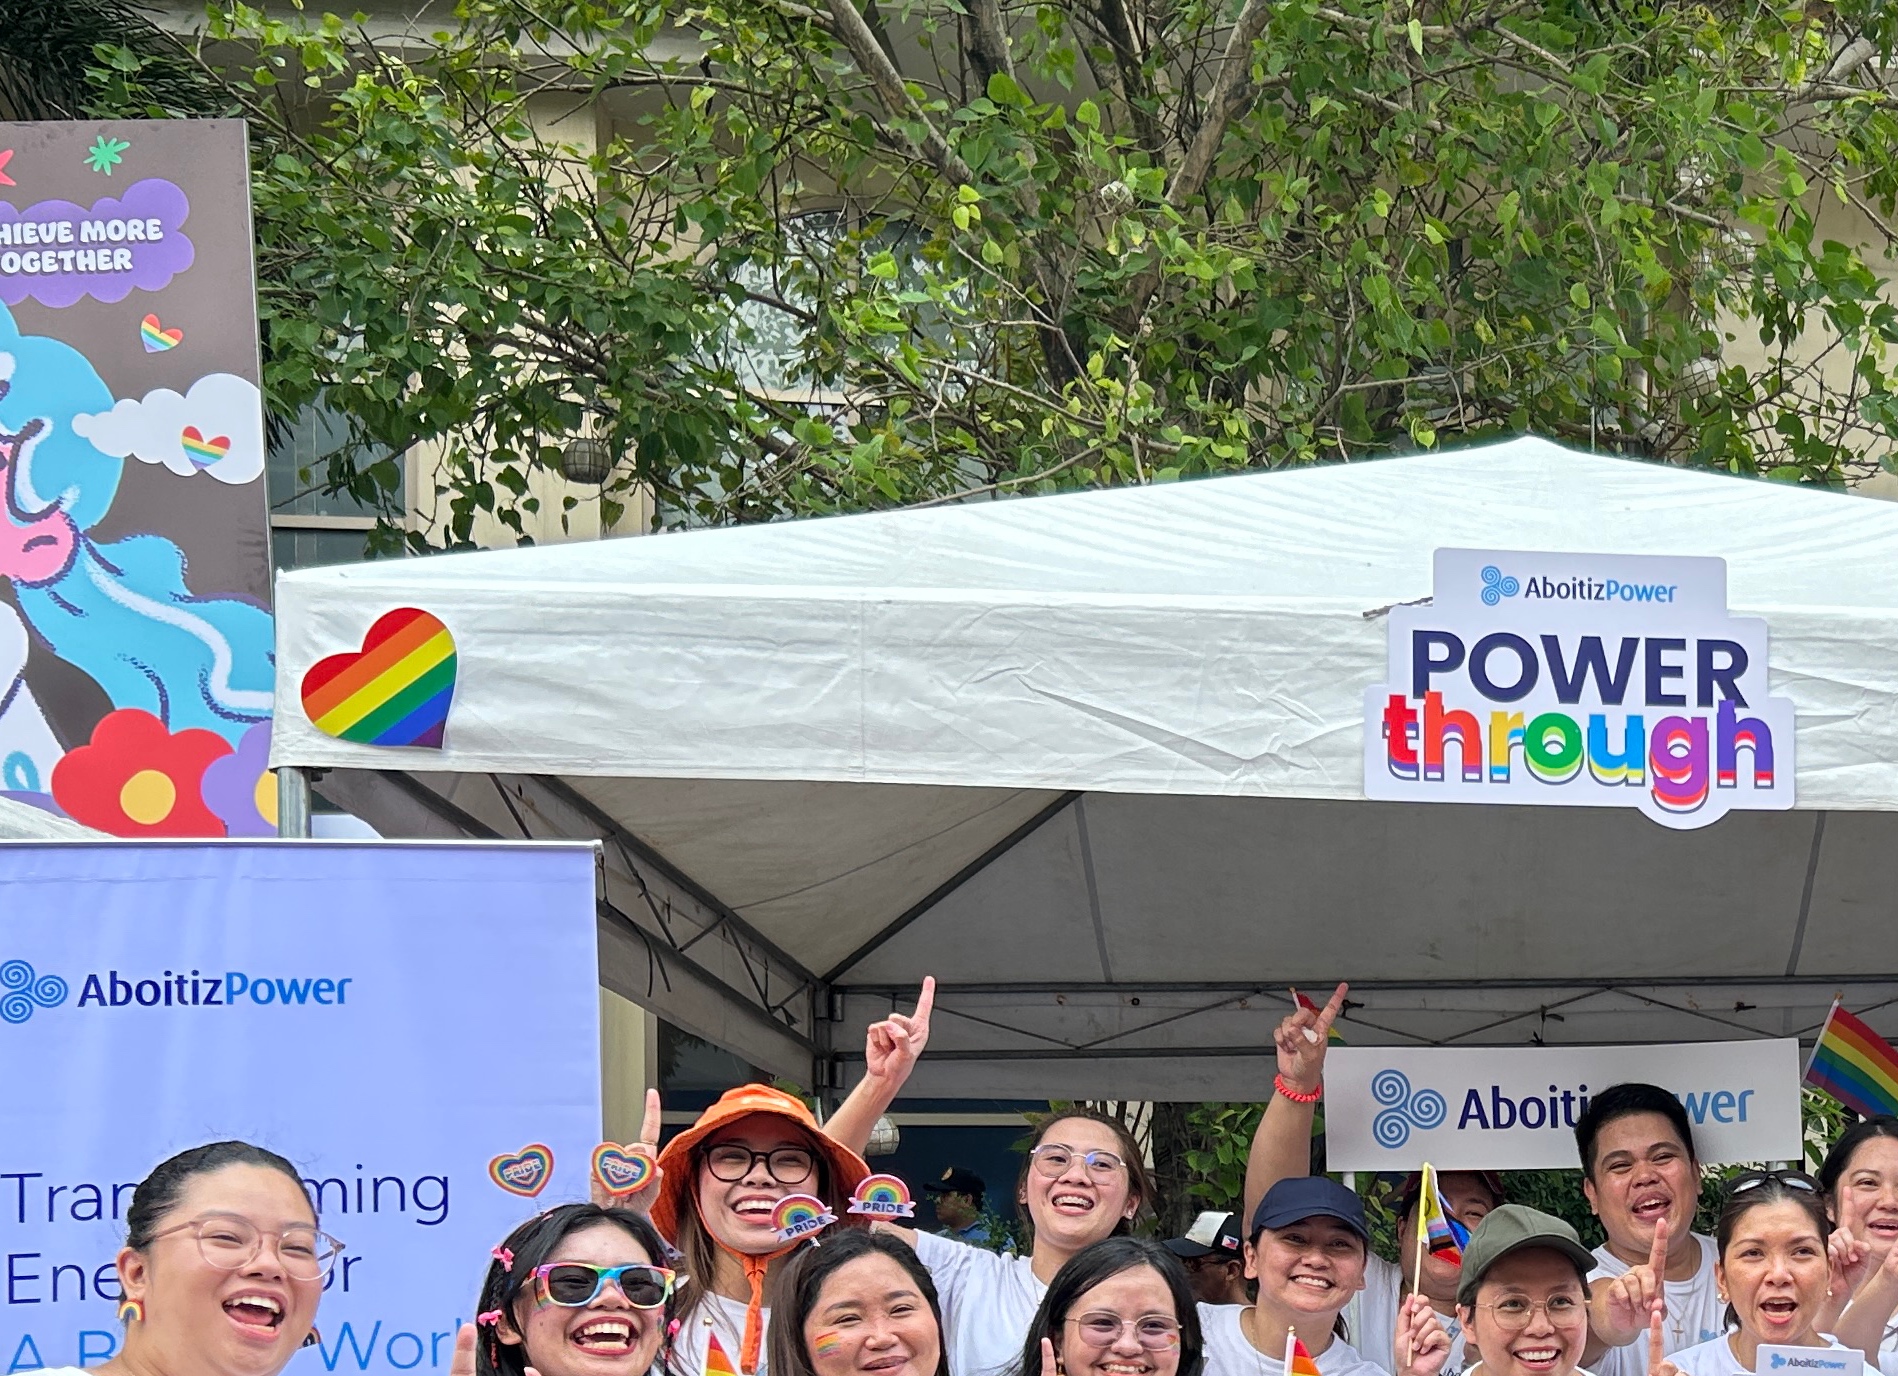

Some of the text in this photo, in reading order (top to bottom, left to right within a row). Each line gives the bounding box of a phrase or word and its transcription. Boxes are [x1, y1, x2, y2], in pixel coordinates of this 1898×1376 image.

[80, 219, 163, 243] MORE
[1524, 575, 1677, 603] AboitizPower
[1411, 629, 1750, 709] POWER
[1384, 690, 1774, 813] through
[77, 969, 353, 1008] AboitizPower
[1457, 1084, 1755, 1132] Aboitiwer
[0, 1163, 450, 1227] Tranming
[863, 1201, 904, 1214] PRIDE
[785, 1215, 827, 1238] PRIDE
[1786, 1357, 1847, 1370] AboitizPower
